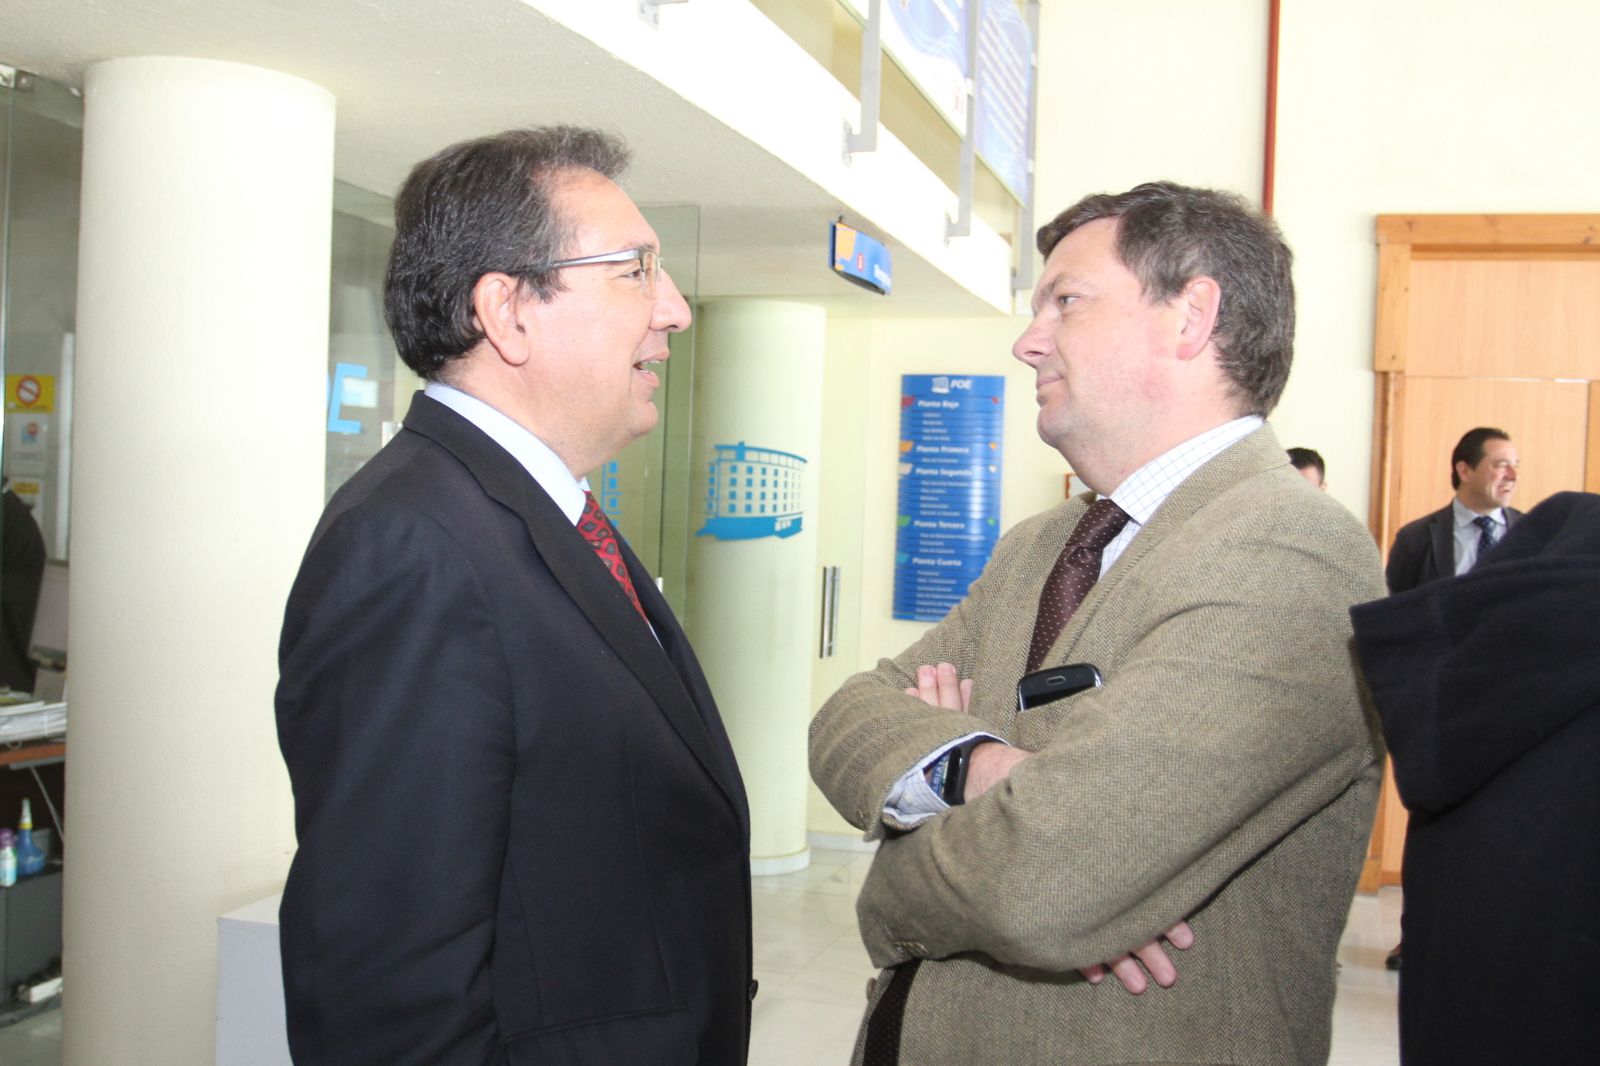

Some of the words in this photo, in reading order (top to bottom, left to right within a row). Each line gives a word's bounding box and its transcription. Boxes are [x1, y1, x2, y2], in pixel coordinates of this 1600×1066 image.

[917, 400, 941, 408] Planta
[916, 445, 940, 453] Planta
[915, 467, 939, 475] Planta
[913, 519, 937, 528] Planta
[912, 557, 935, 566] Planta
